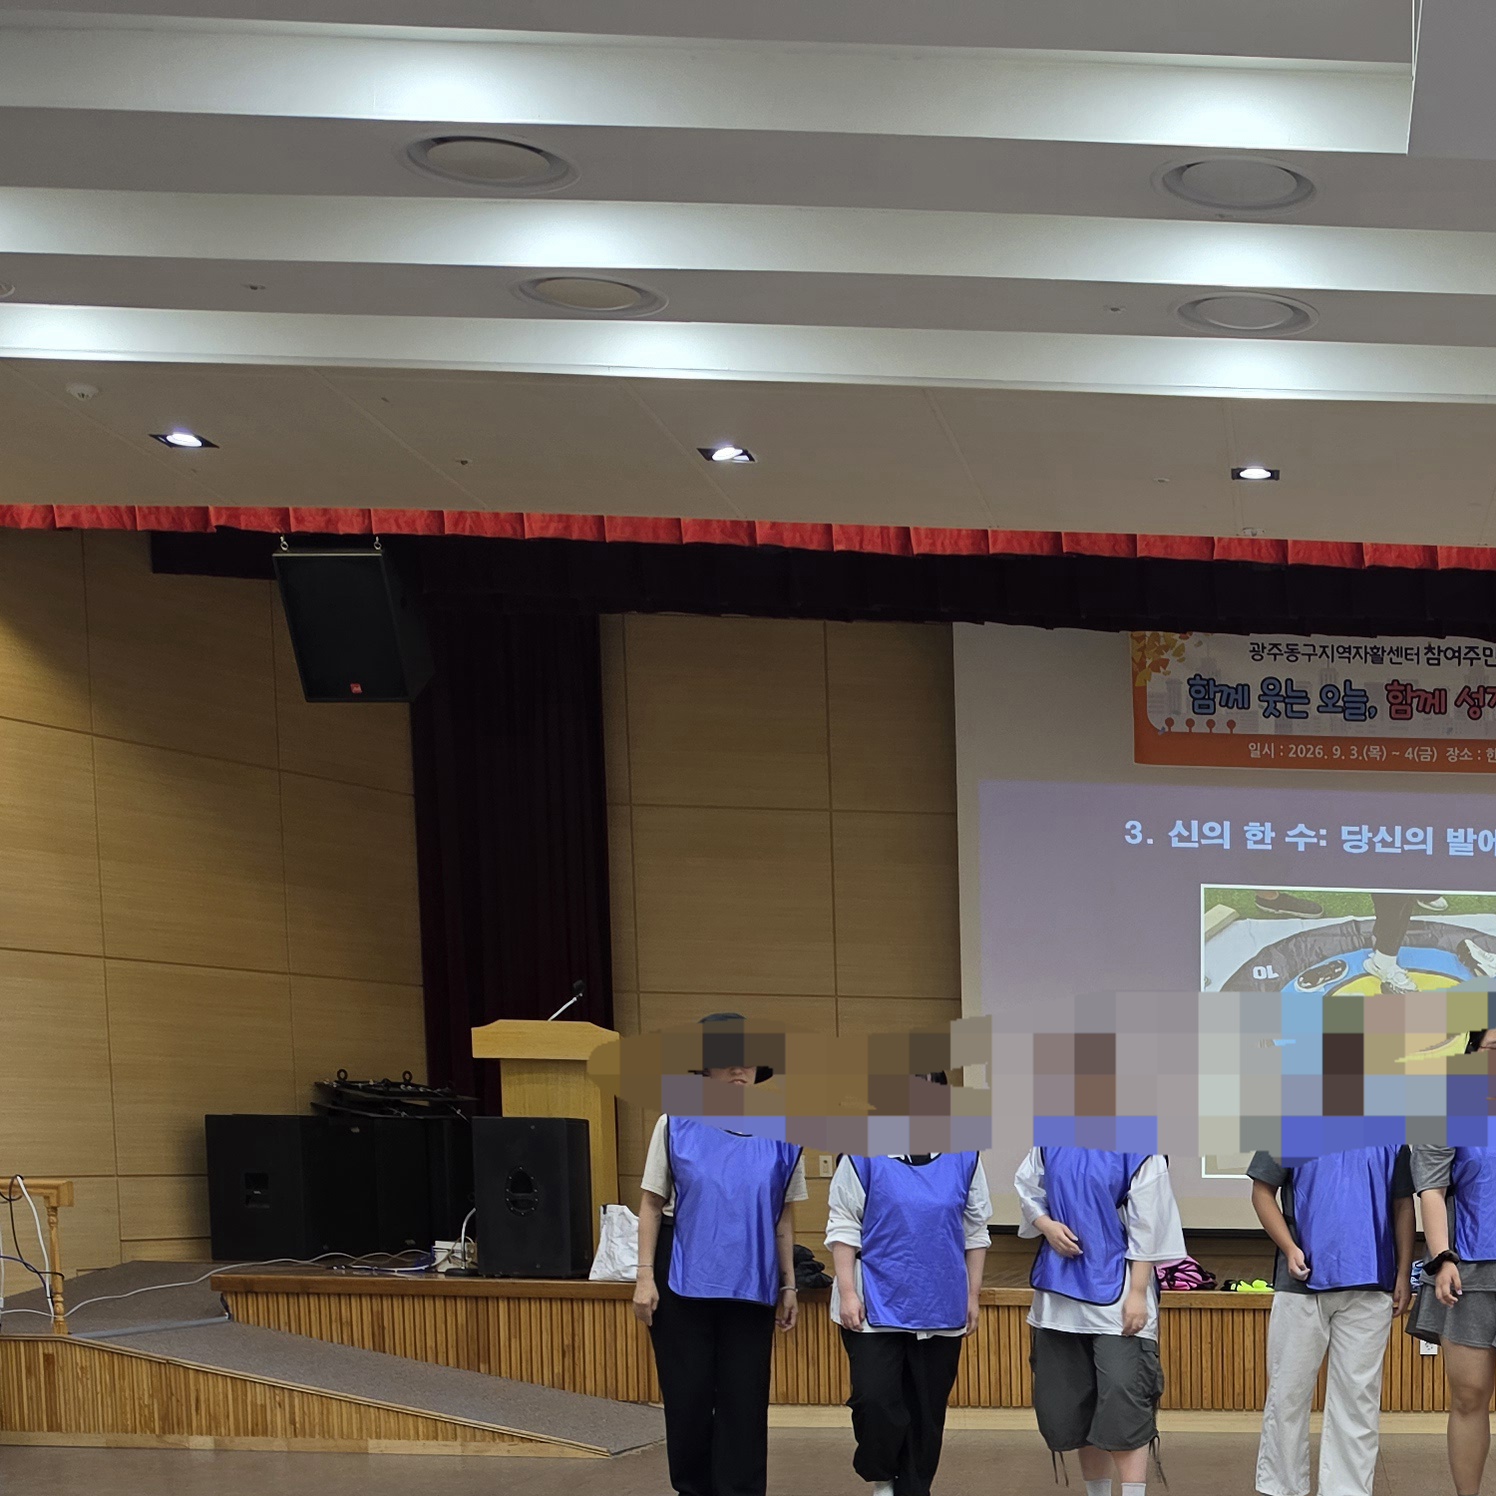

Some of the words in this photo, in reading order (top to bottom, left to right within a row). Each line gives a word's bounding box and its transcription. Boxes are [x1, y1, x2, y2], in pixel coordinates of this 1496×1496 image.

[1248, 642, 1420, 665] 광주동구지역자활센터
[1187, 674, 1251, 716] 함께
[1258, 676, 1310, 719] 웃는
[1317, 678, 1378, 721] 오늘,
[1385, 679, 1448, 721] 함께
[1248, 743, 1275, 758] 일시
[1288, 744, 1328, 759] 2026.
[1404, 745, 1438, 763] 4(금)
[1446, 746, 1473, 763] 장소
[1124, 820, 1154, 845] 3.
[1168, 820, 1231, 849] 신의
[1243, 822, 1276, 850] 한
[1285, 823, 1327, 851] 수:
[1341, 825, 1433, 855] 당신의
[1253, 965, 1279, 979] 10
